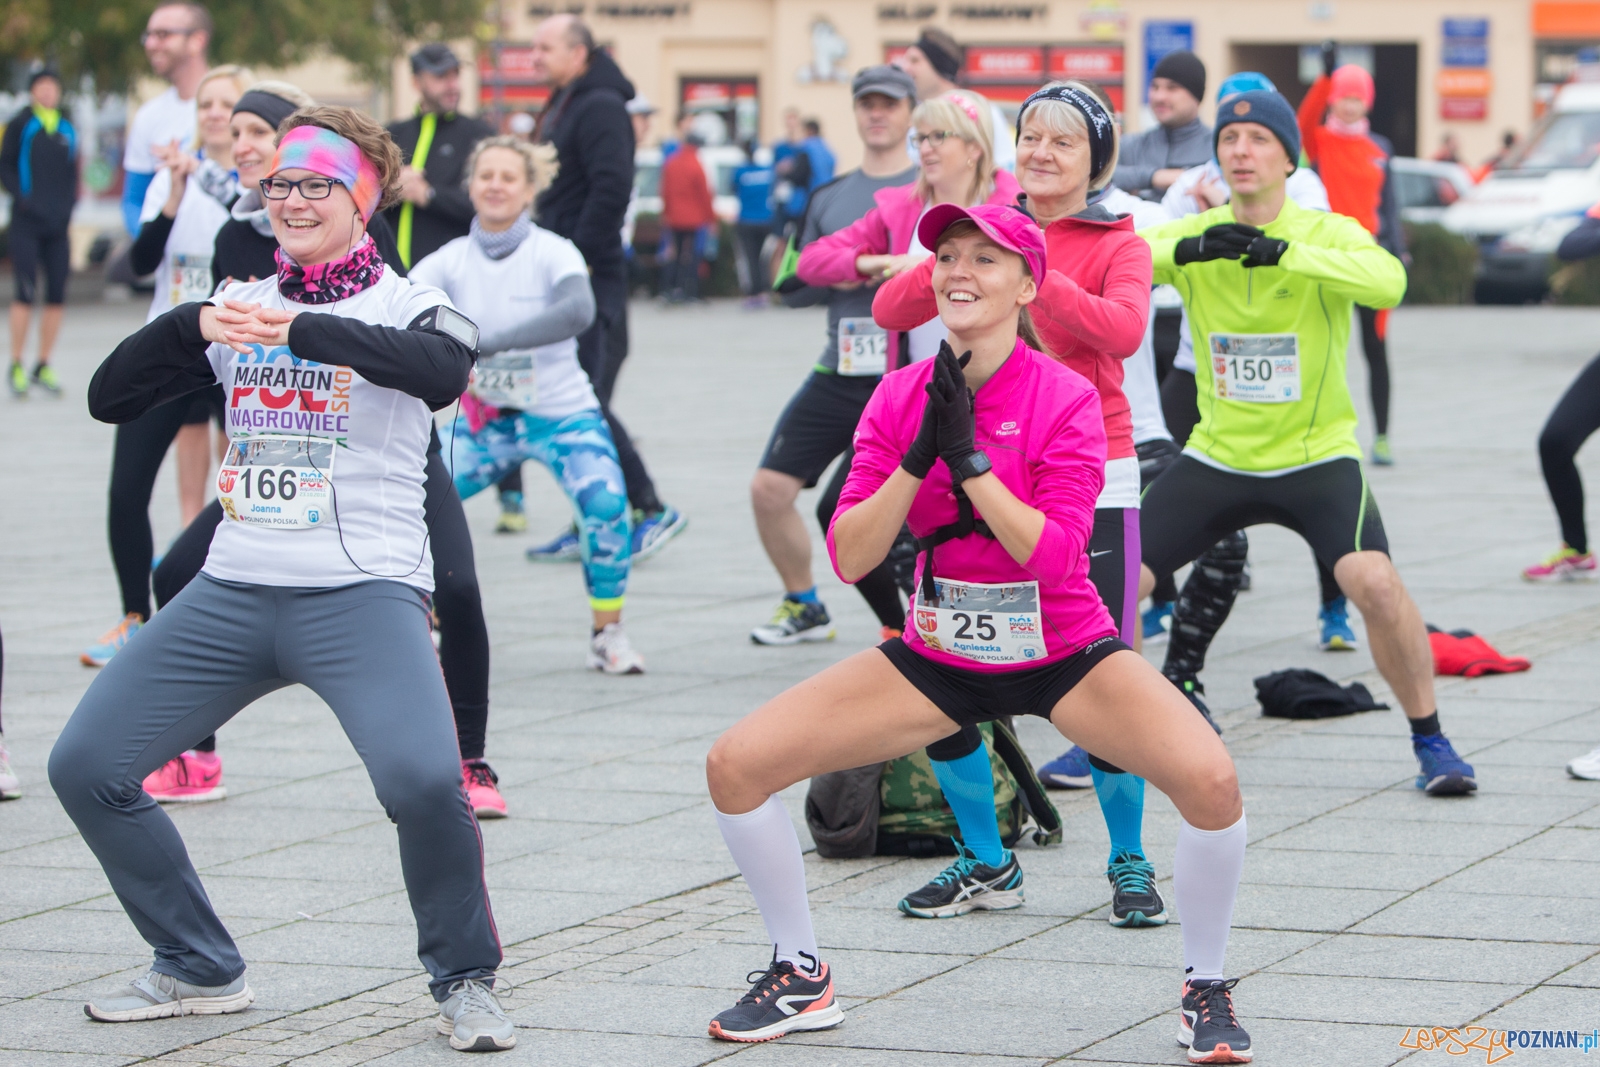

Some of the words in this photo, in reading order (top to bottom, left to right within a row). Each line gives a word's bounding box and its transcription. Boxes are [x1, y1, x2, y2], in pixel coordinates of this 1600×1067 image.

[234, 366, 333, 391] MARATON
[478, 370, 515, 391] 224
[1228, 357, 1273, 382] 150
[229, 408, 350, 432] WĄGROWIEC
[240, 468, 298, 501] 166
[250, 504, 282, 513] Joanna
[272, 517, 298, 525] POLSKA
[952, 612, 997, 641] 25
[953, 641, 1002, 652] Agnieszka
[986, 653, 1015, 661] POLSKA
